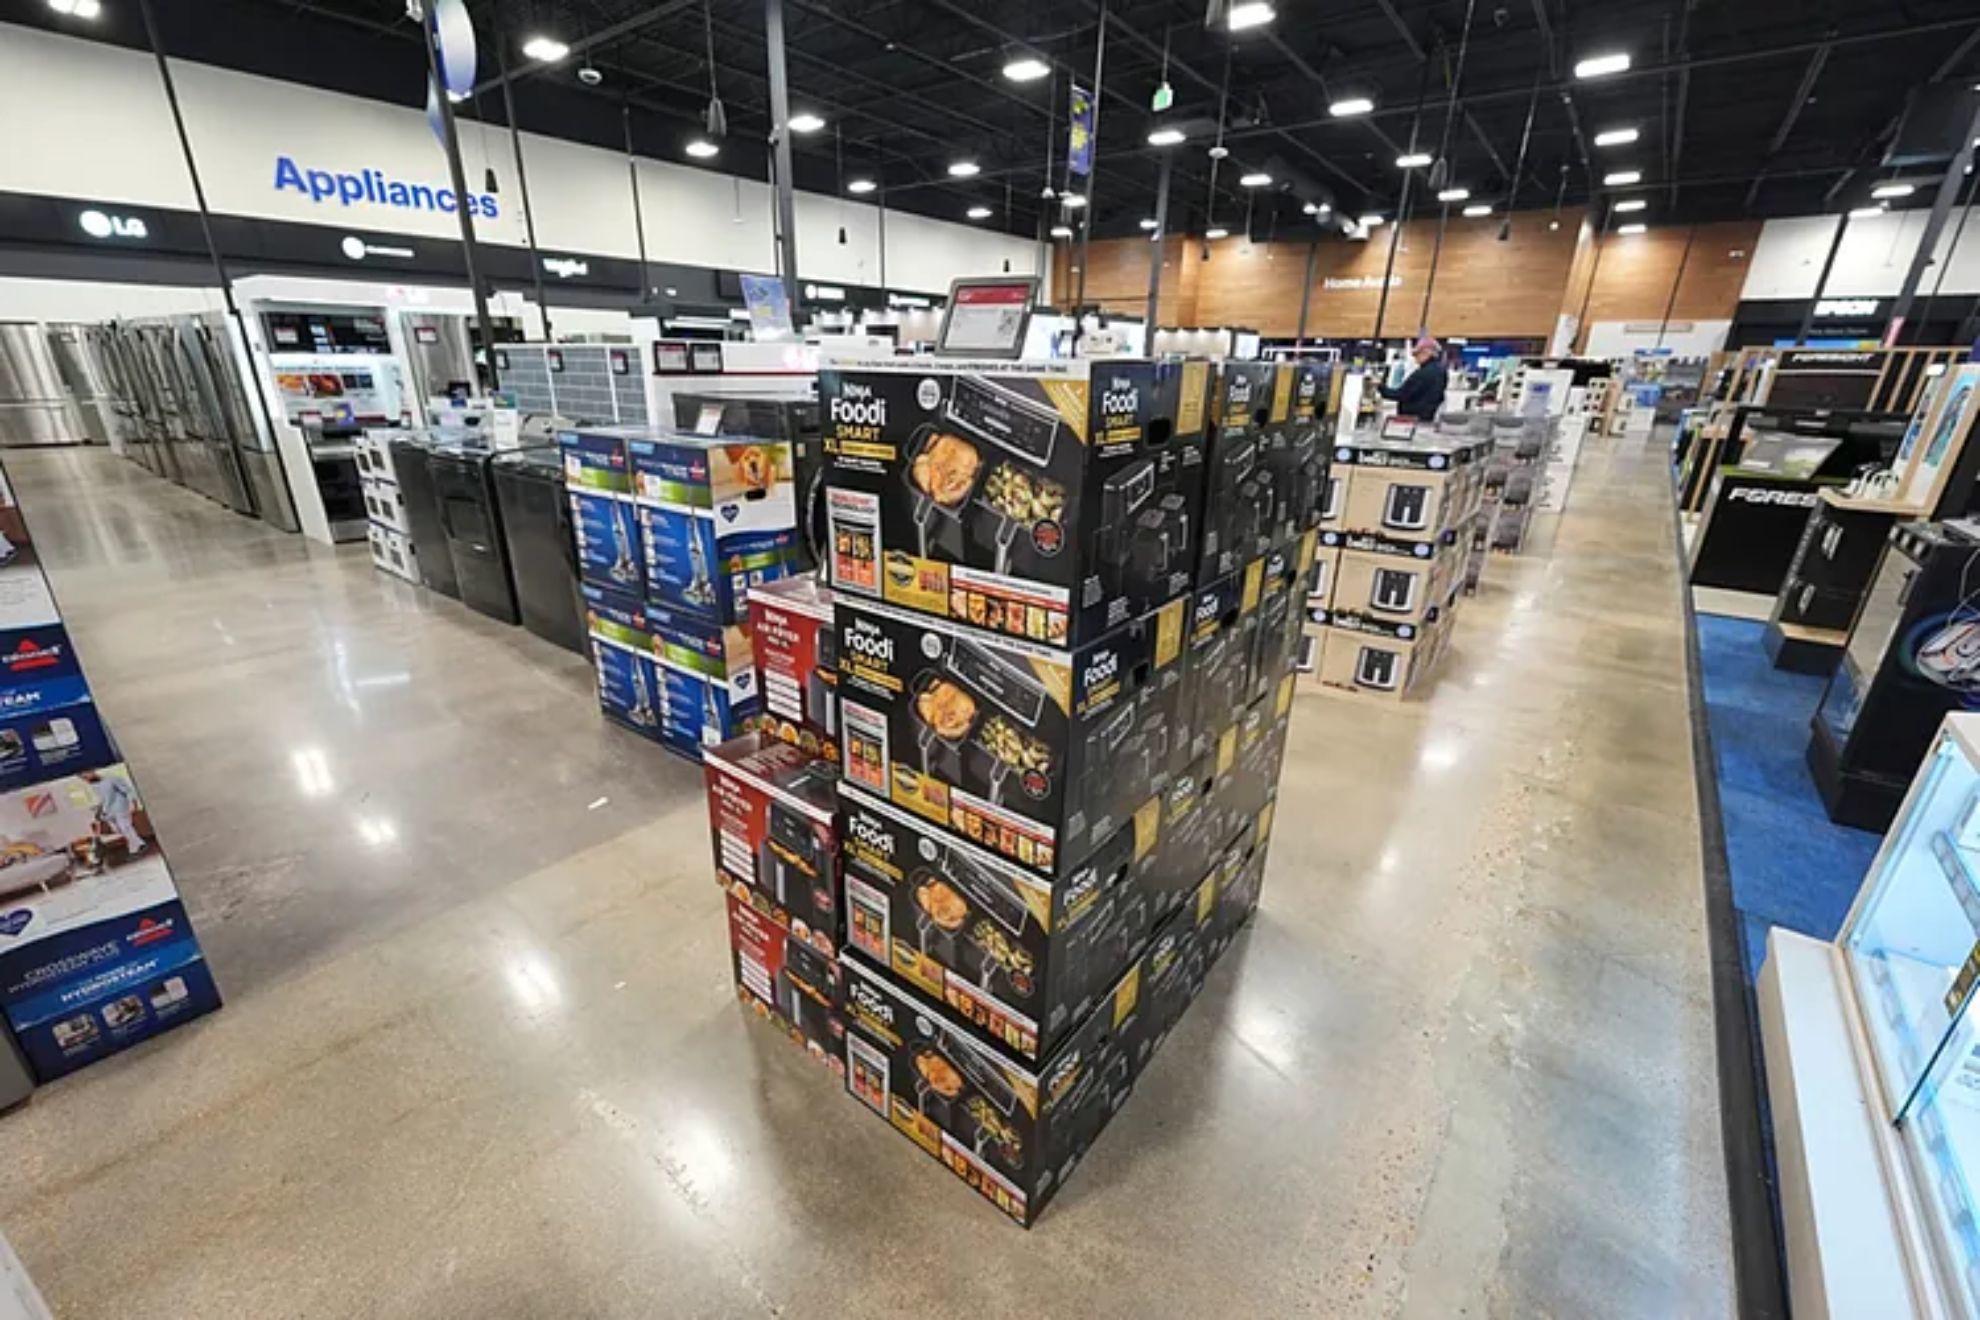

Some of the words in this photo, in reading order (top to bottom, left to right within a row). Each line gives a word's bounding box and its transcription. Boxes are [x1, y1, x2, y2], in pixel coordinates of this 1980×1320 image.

[274, 156, 500, 219] Appliances
[111, 215, 148, 238] LG
[1323, 277, 1360, 289] Home
[831, 397, 886, 426] Foodi
[1103, 387, 1138, 415] Foodi
[823, 438, 840, 453] XL
[836, 426, 881, 442] SMART
[843, 627, 894, 662] Foodi
